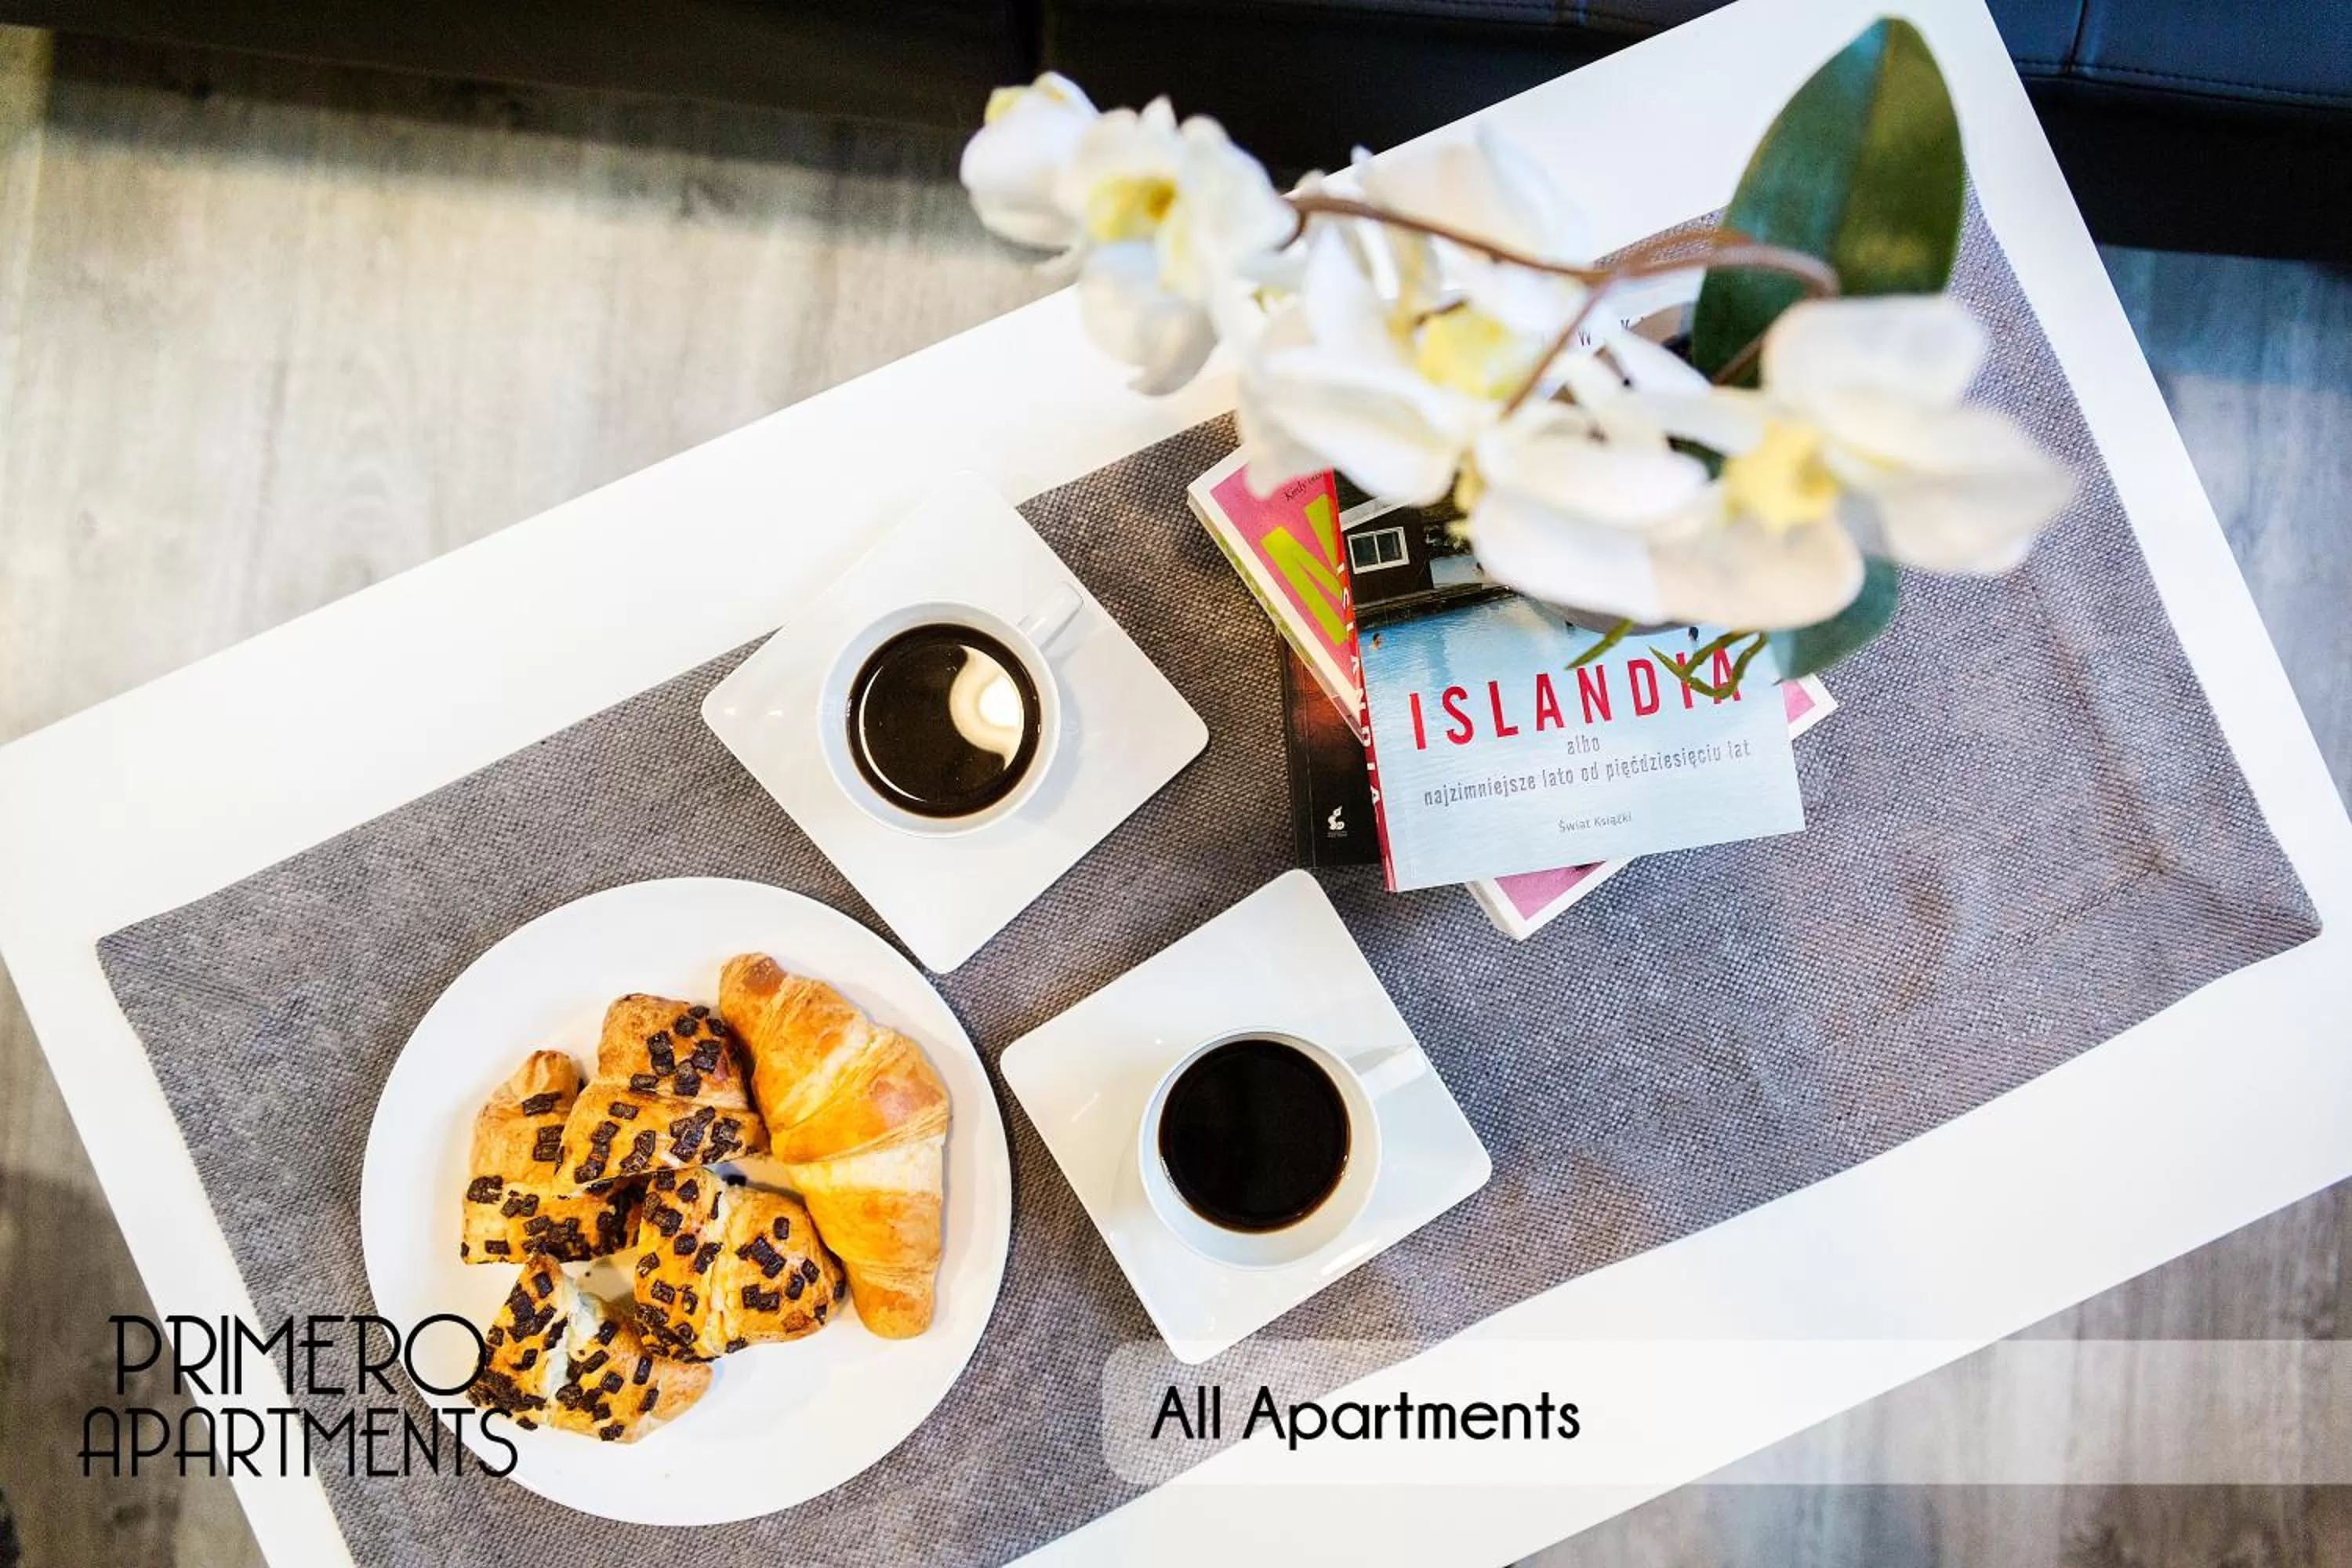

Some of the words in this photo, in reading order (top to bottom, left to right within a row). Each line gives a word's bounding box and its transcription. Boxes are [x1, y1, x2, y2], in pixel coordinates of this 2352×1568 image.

[1409, 646, 1741, 750] ISLANDIA
[1567, 734, 1600, 755] albo
[1424, 775, 1537, 807] najzimniejsze
[1543, 767, 1573, 788] lato
[1581, 762, 1599, 782] od
[1606, 744, 1722, 782] pięćdziesięciu
[1727, 739, 1751, 760] lat
[1558, 815, 1592, 833] Świat
